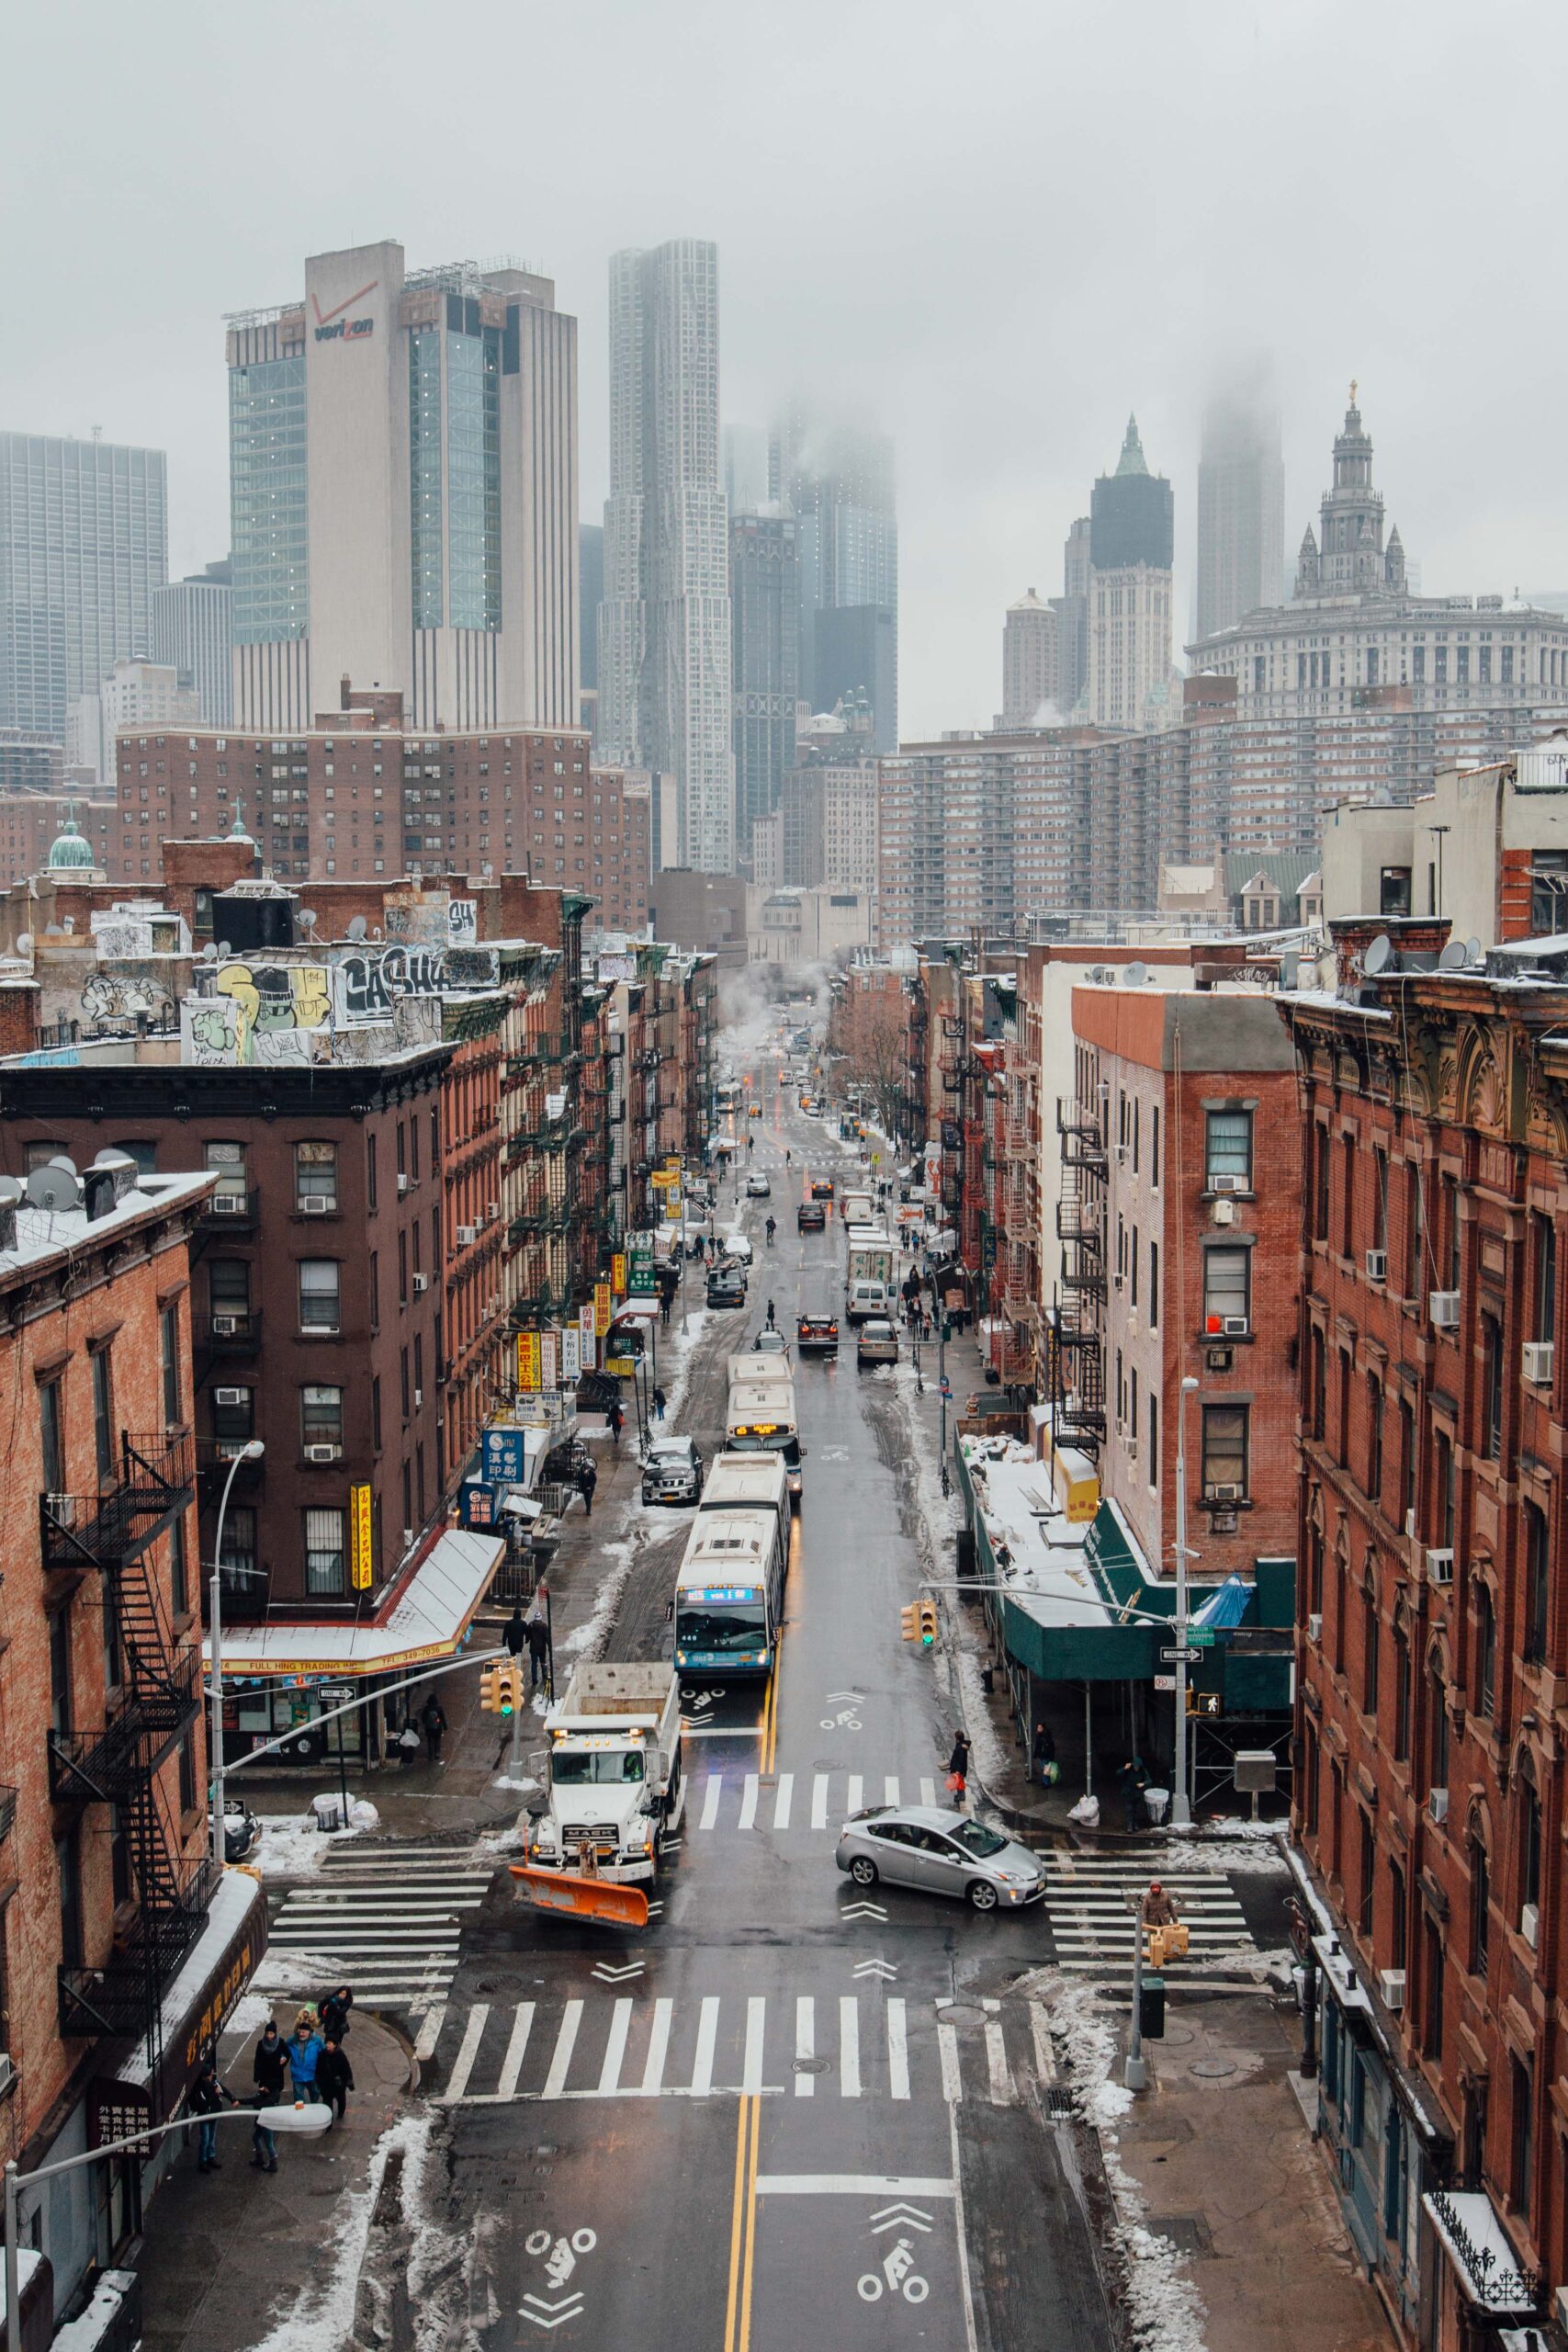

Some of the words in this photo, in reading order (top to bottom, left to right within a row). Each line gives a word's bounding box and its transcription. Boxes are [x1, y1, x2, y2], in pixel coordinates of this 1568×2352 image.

[314, 318, 374, 341] verizon
[489, 1432, 514, 1451] Sino
[249, 1662, 271, 1670] FULL
[275, 1662, 297, 1670] HING
[299, 1661, 340, 1670] TRADING
